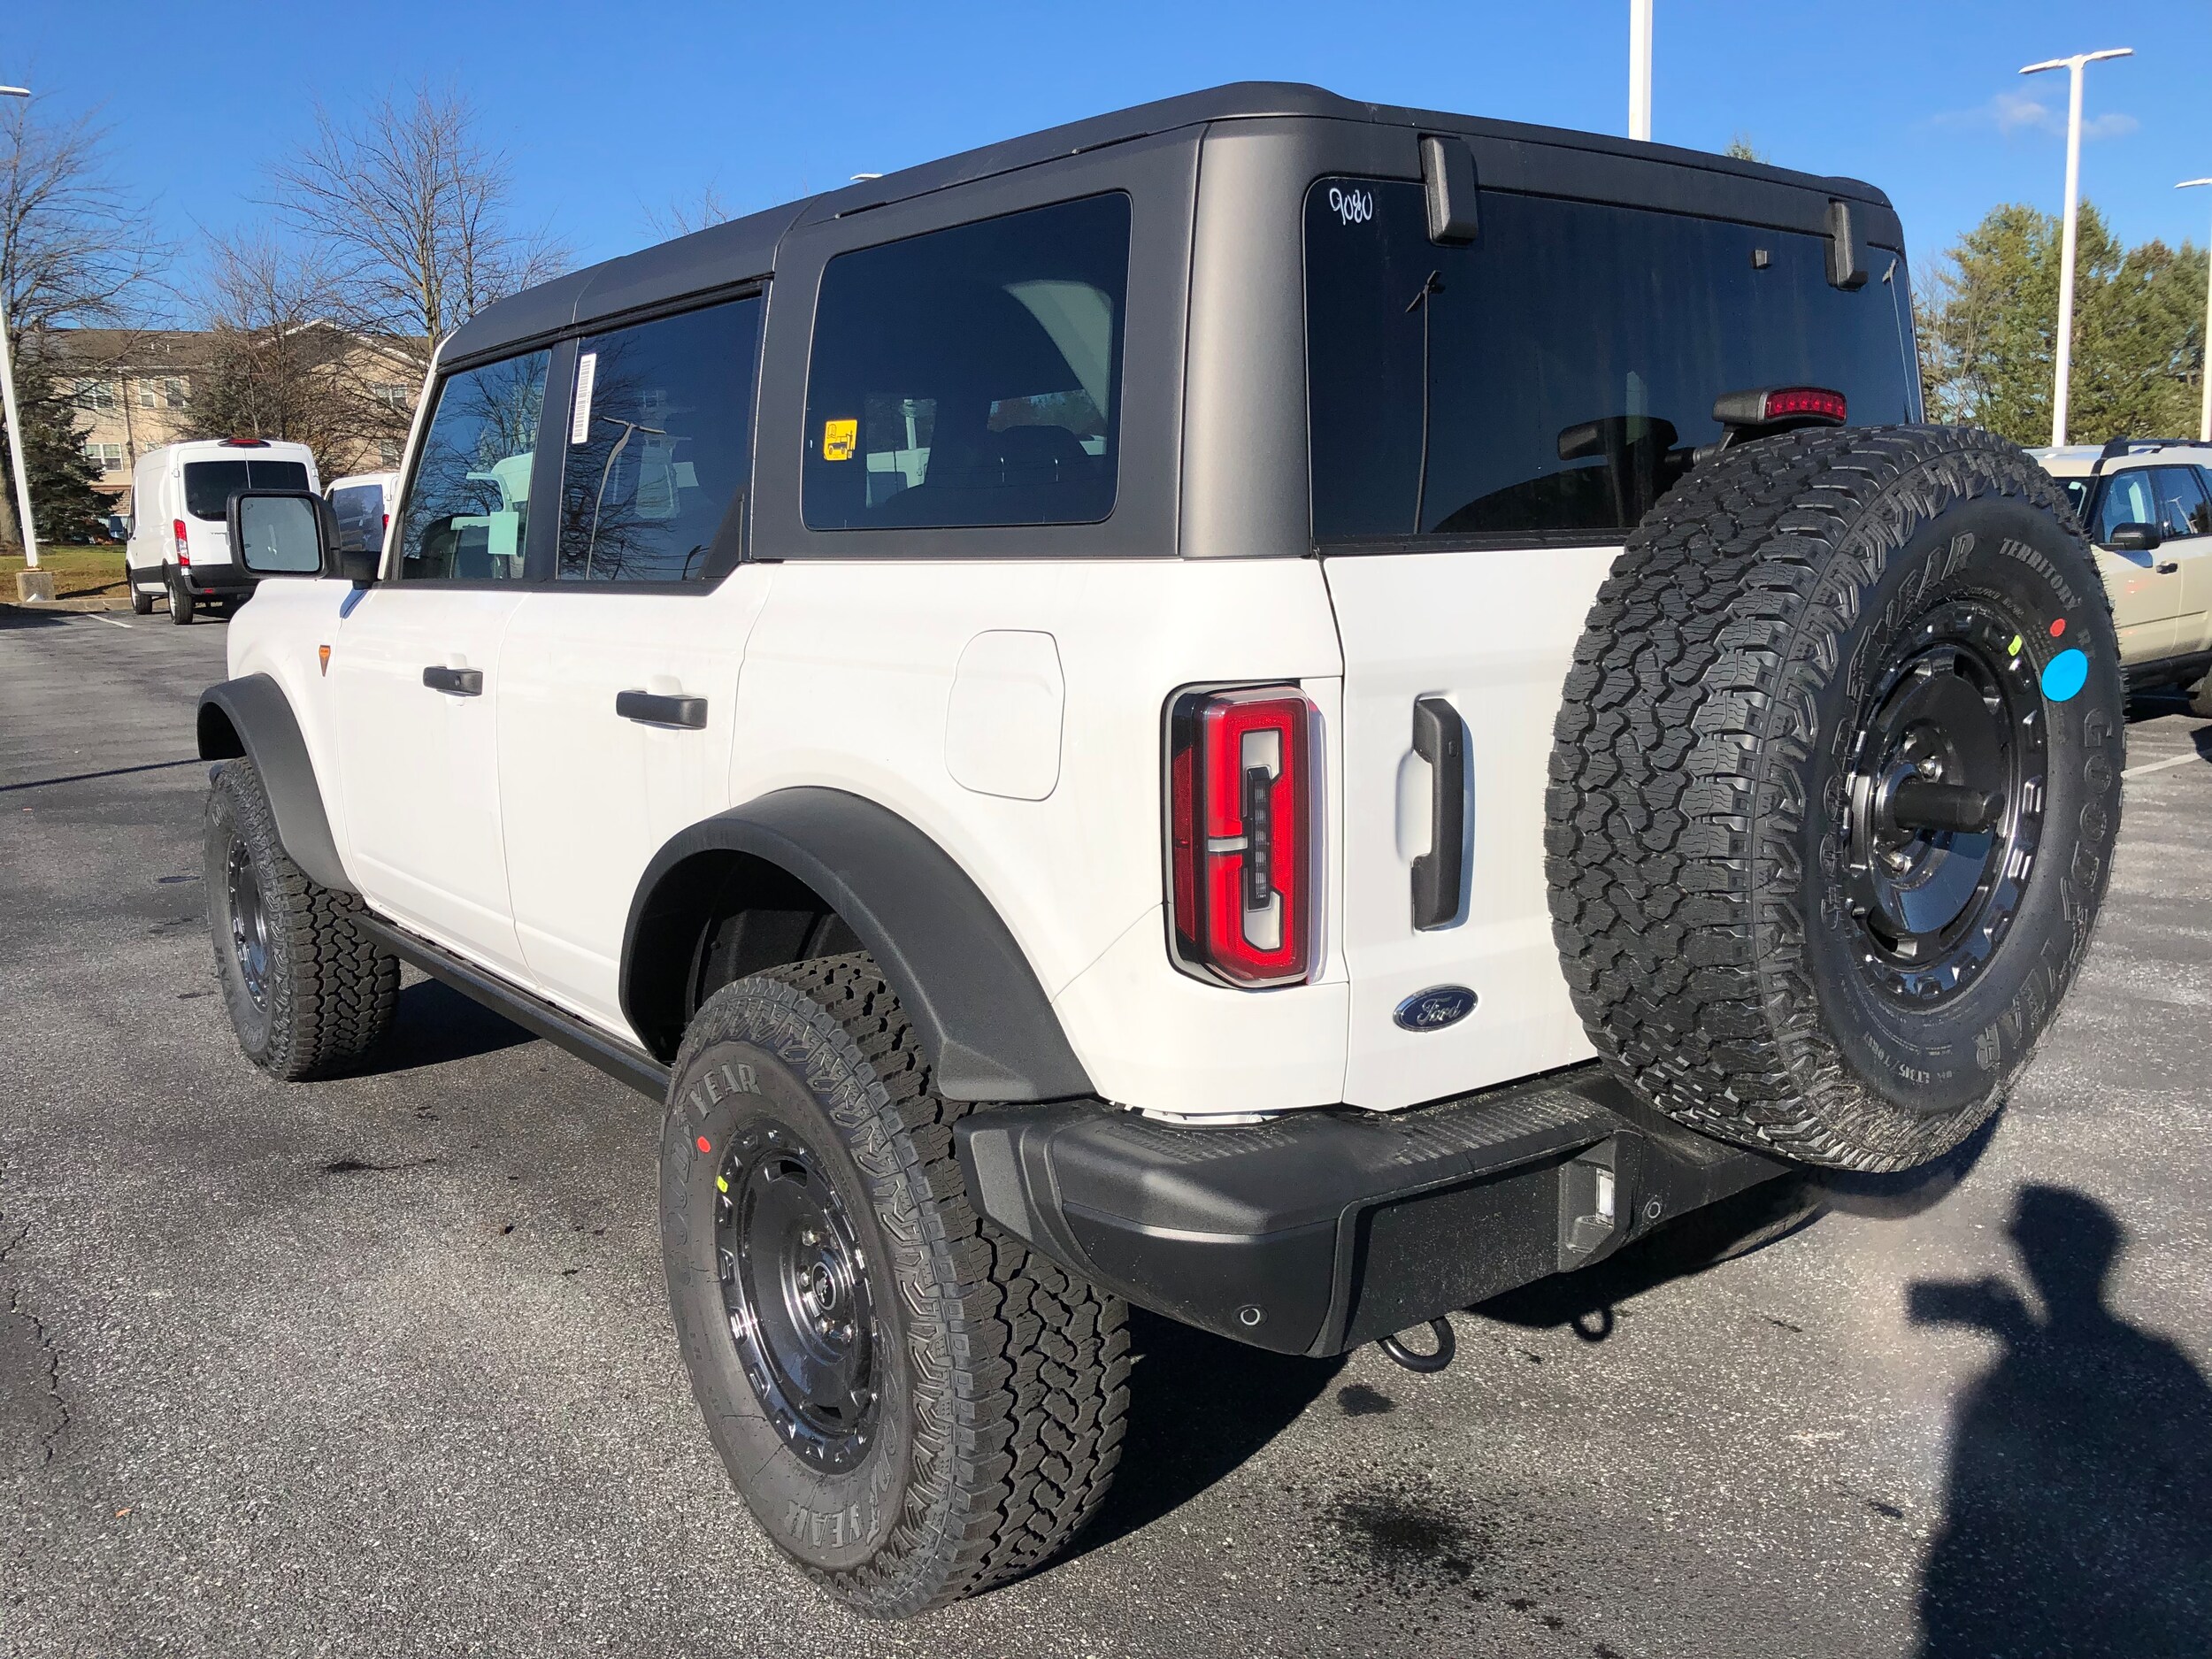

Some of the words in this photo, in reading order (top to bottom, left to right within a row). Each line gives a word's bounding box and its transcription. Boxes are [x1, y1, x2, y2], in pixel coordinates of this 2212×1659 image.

[1329, 187, 1373, 226] 9080
[2000, 538, 2078, 611] TERRITORY
[1417, 996, 1463, 1025] Ford
